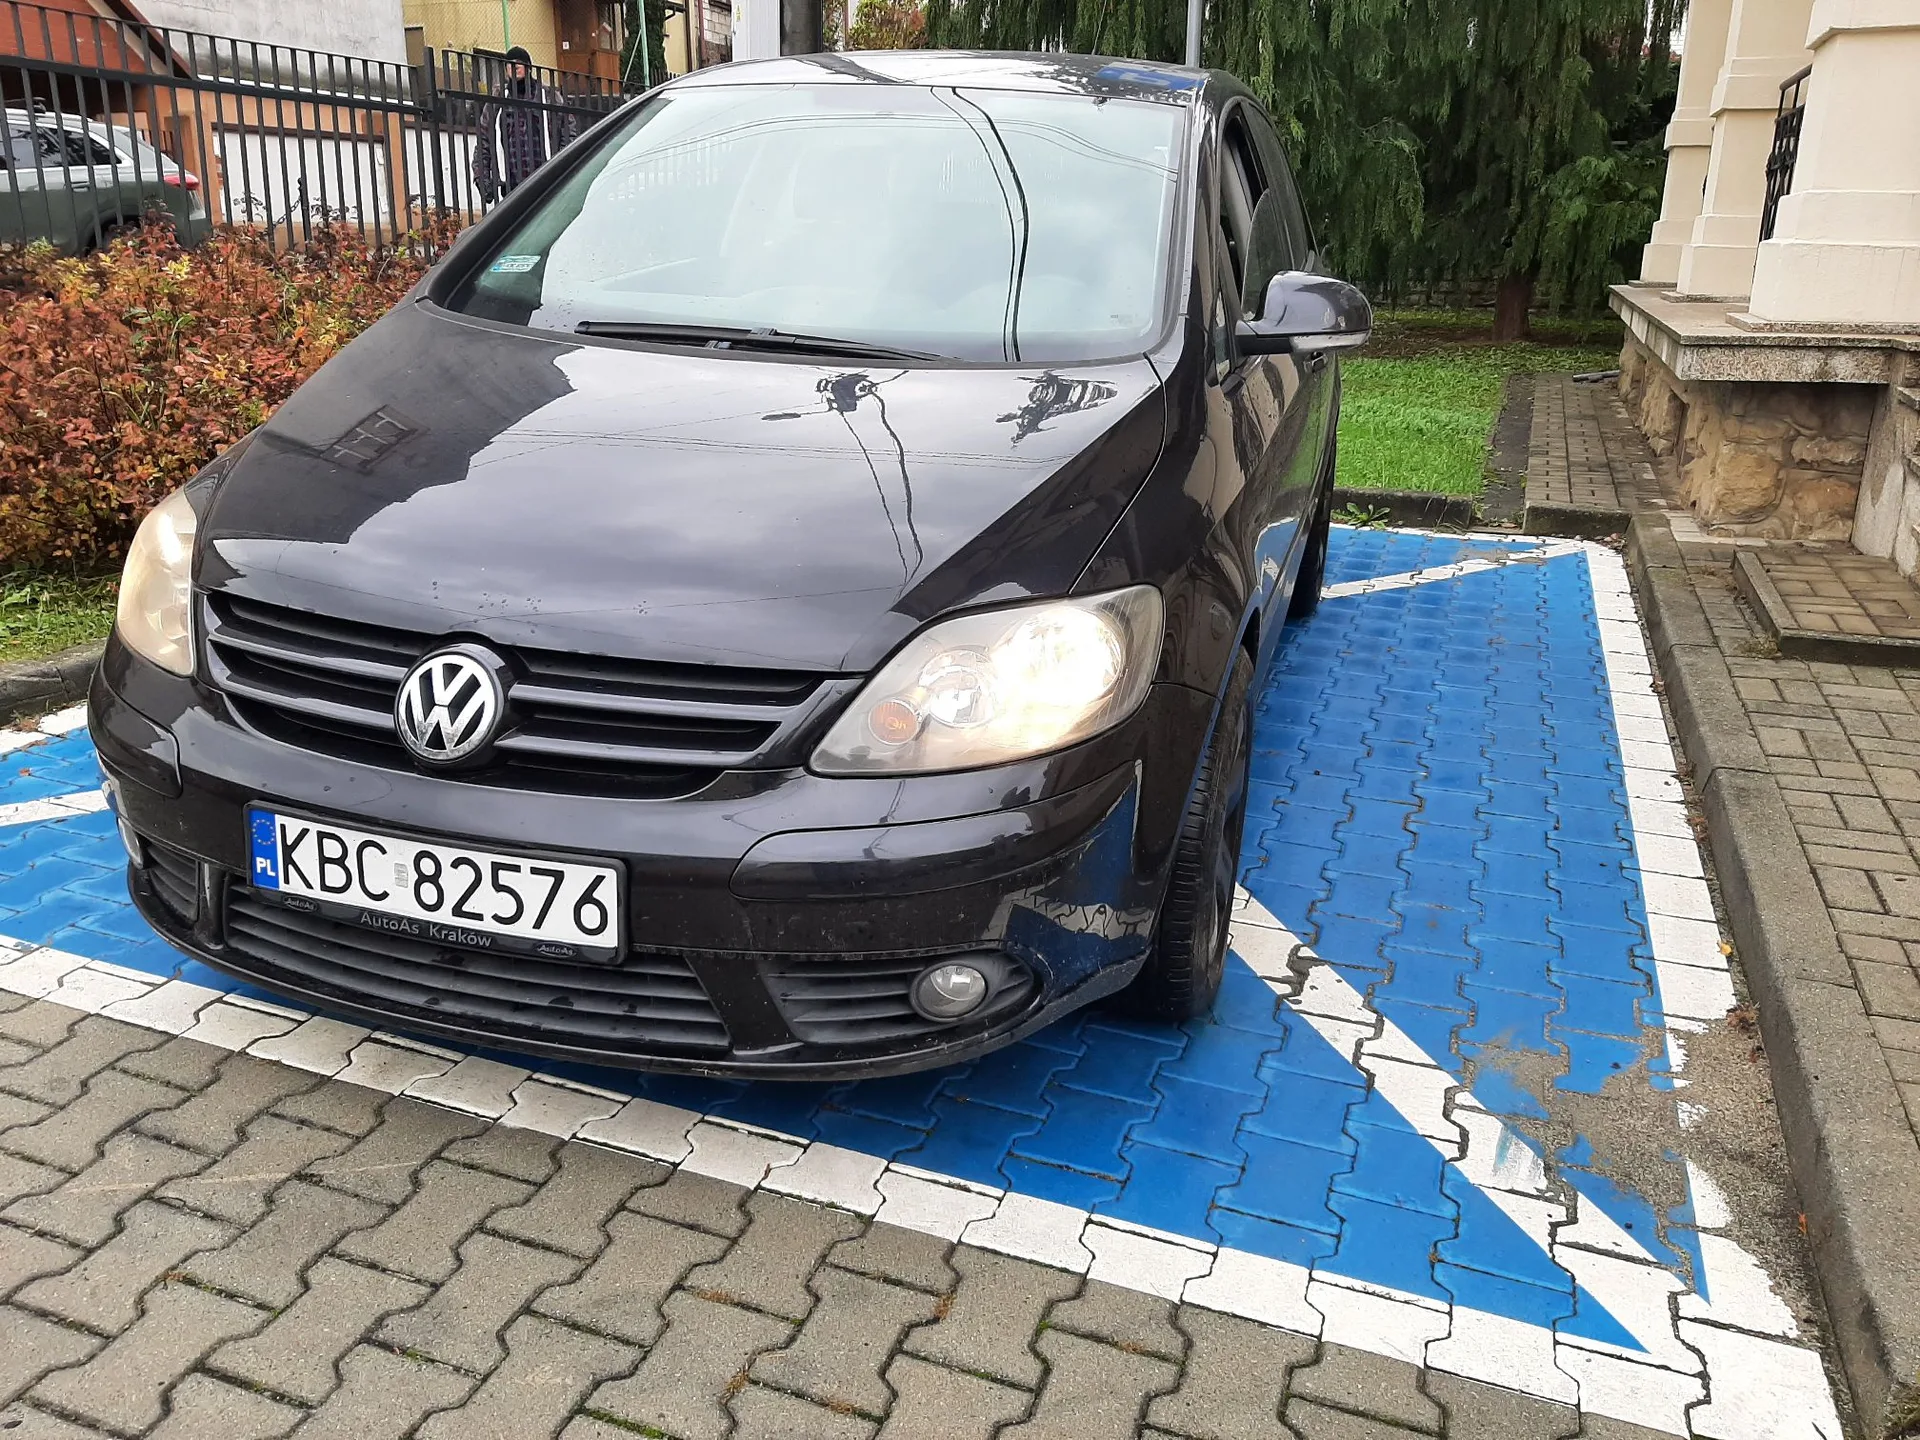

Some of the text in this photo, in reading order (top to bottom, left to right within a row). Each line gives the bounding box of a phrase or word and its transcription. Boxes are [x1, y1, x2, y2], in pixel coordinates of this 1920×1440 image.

[399, 655, 495, 760] VW
[255, 857, 276, 877] PL
[280, 823, 609, 936] KBC 82576
[360, 912, 492, 947] AutoAs Kraków
